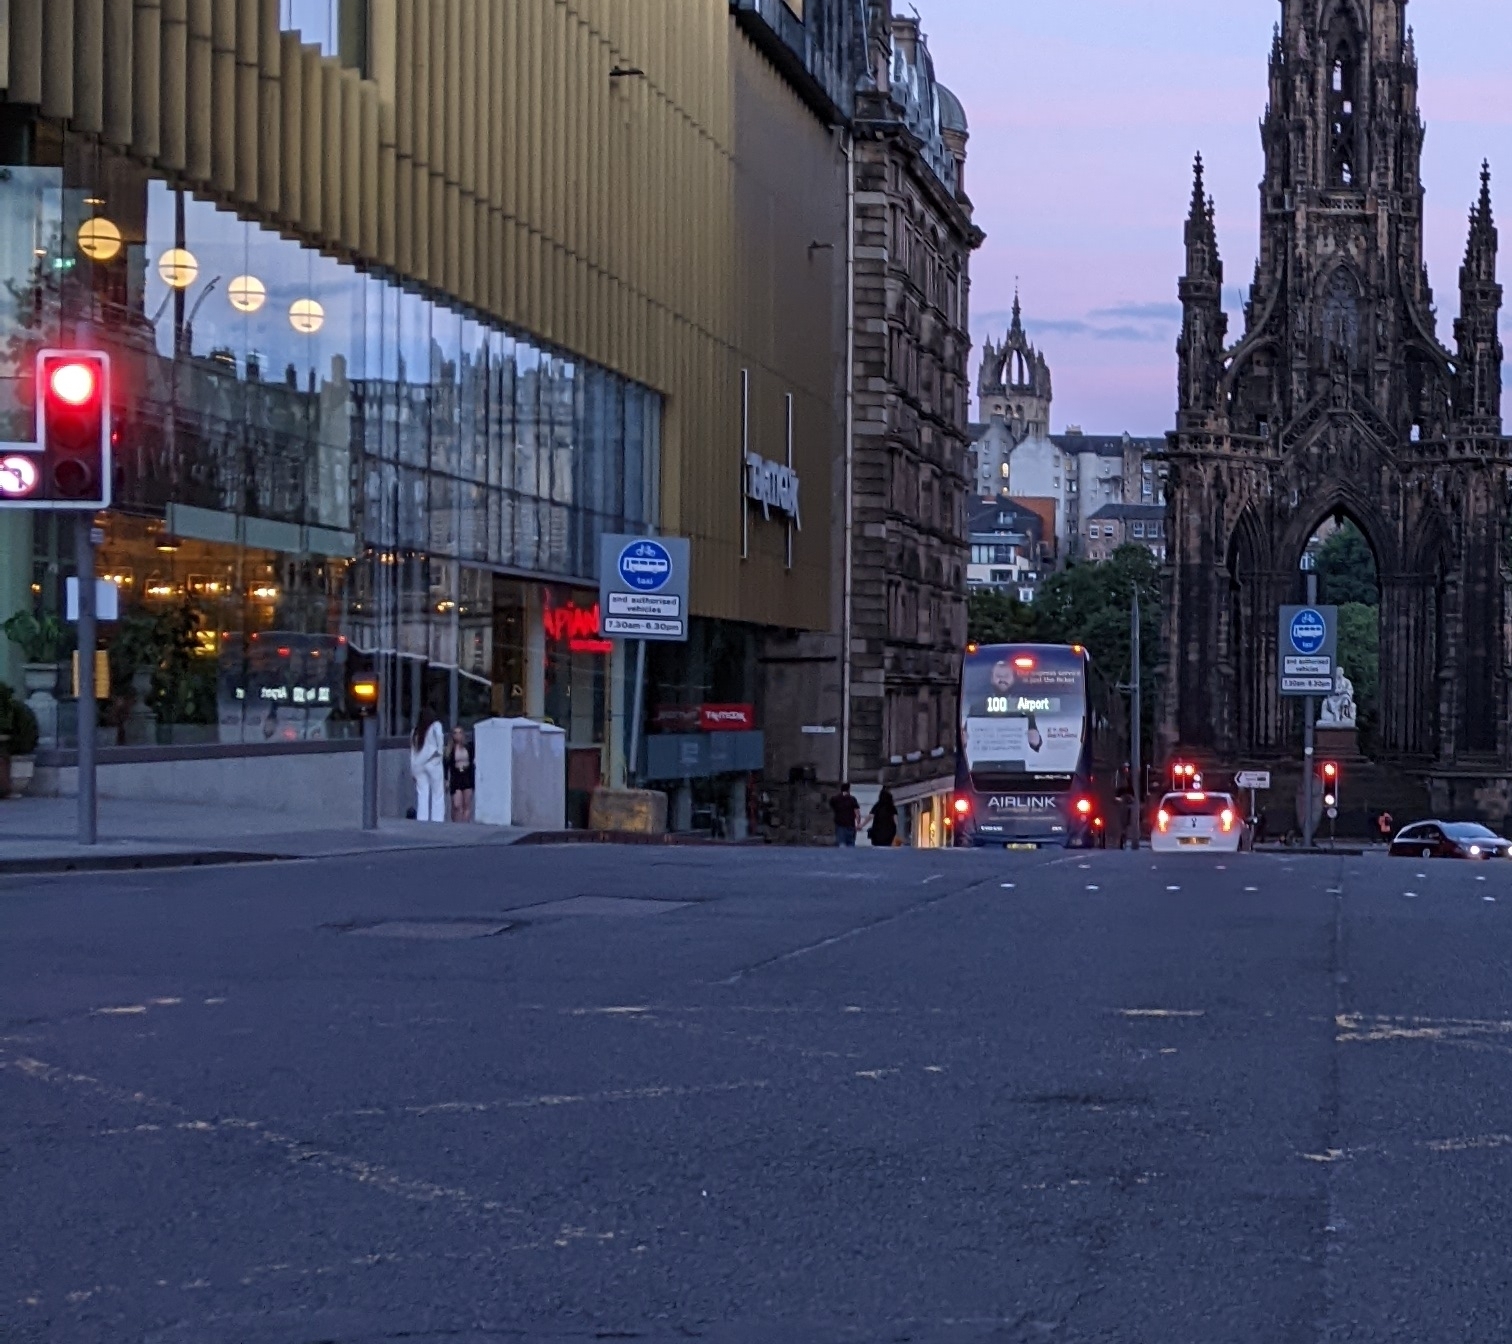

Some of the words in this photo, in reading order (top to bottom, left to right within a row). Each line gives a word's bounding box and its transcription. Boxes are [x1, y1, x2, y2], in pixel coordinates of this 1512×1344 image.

[636, 577, 654, 585] taxi
[987, 696, 1008, 712] 100
[1017, 696, 1050, 712] Airport
[987, 796, 1057, 808] AIRLINK
